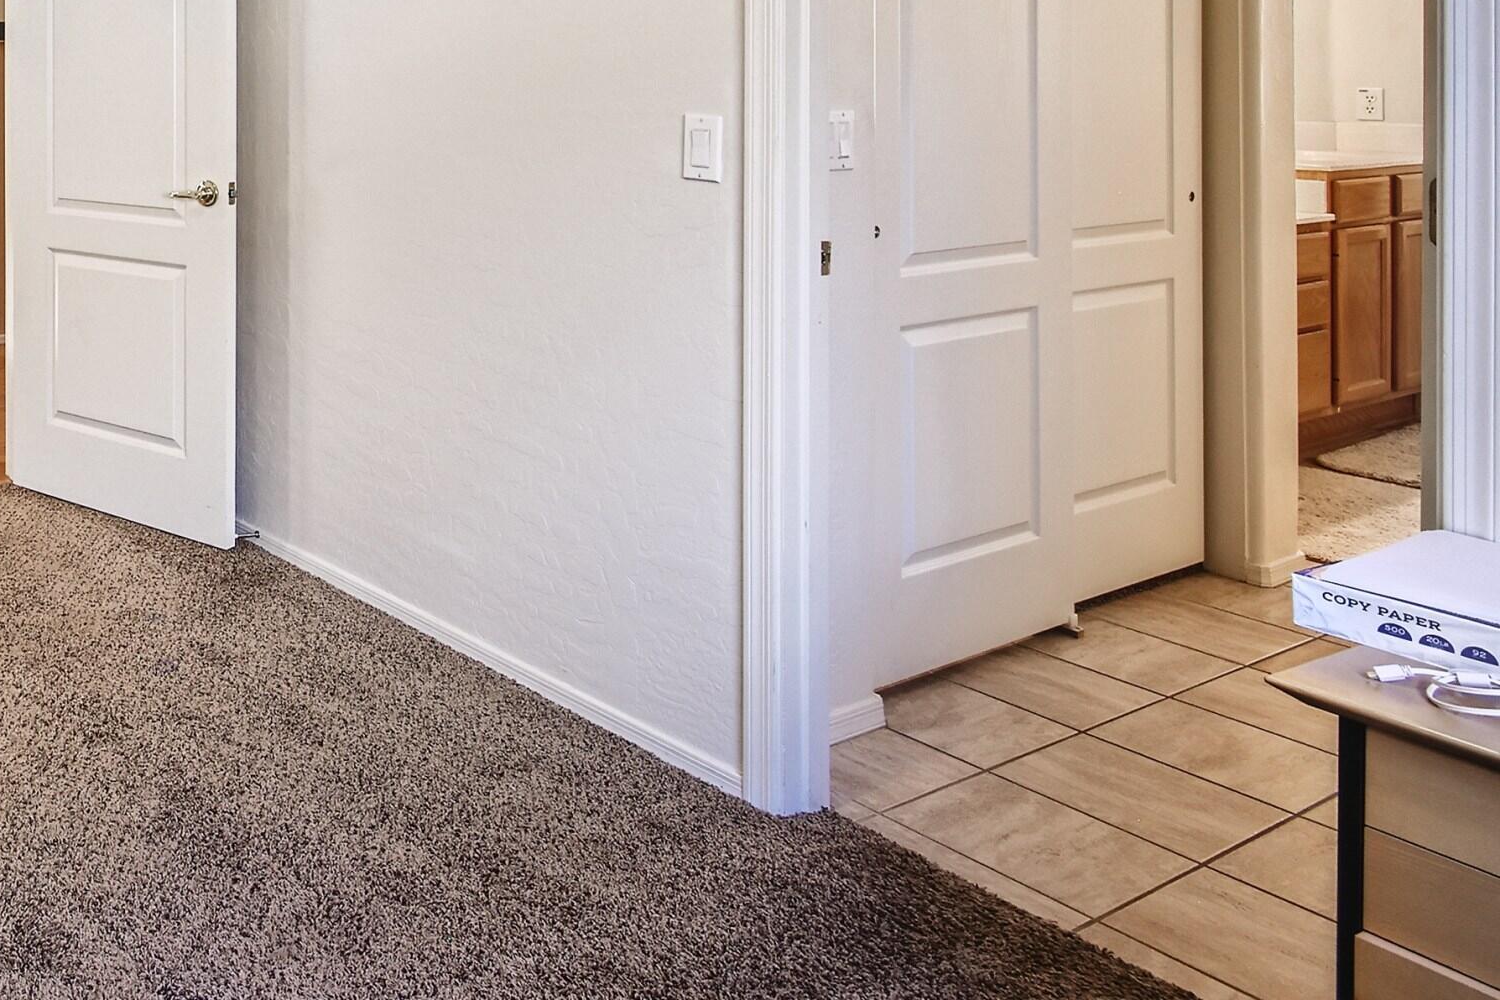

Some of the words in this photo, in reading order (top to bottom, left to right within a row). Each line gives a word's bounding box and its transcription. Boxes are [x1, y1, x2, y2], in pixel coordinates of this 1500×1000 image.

[1322, 591, 1371, 612] COPY
[1377, 606, 1442, 631] PAPER
[1384, 624, 1406, 636] 500
[1472, 649, 1487, 659] 92
